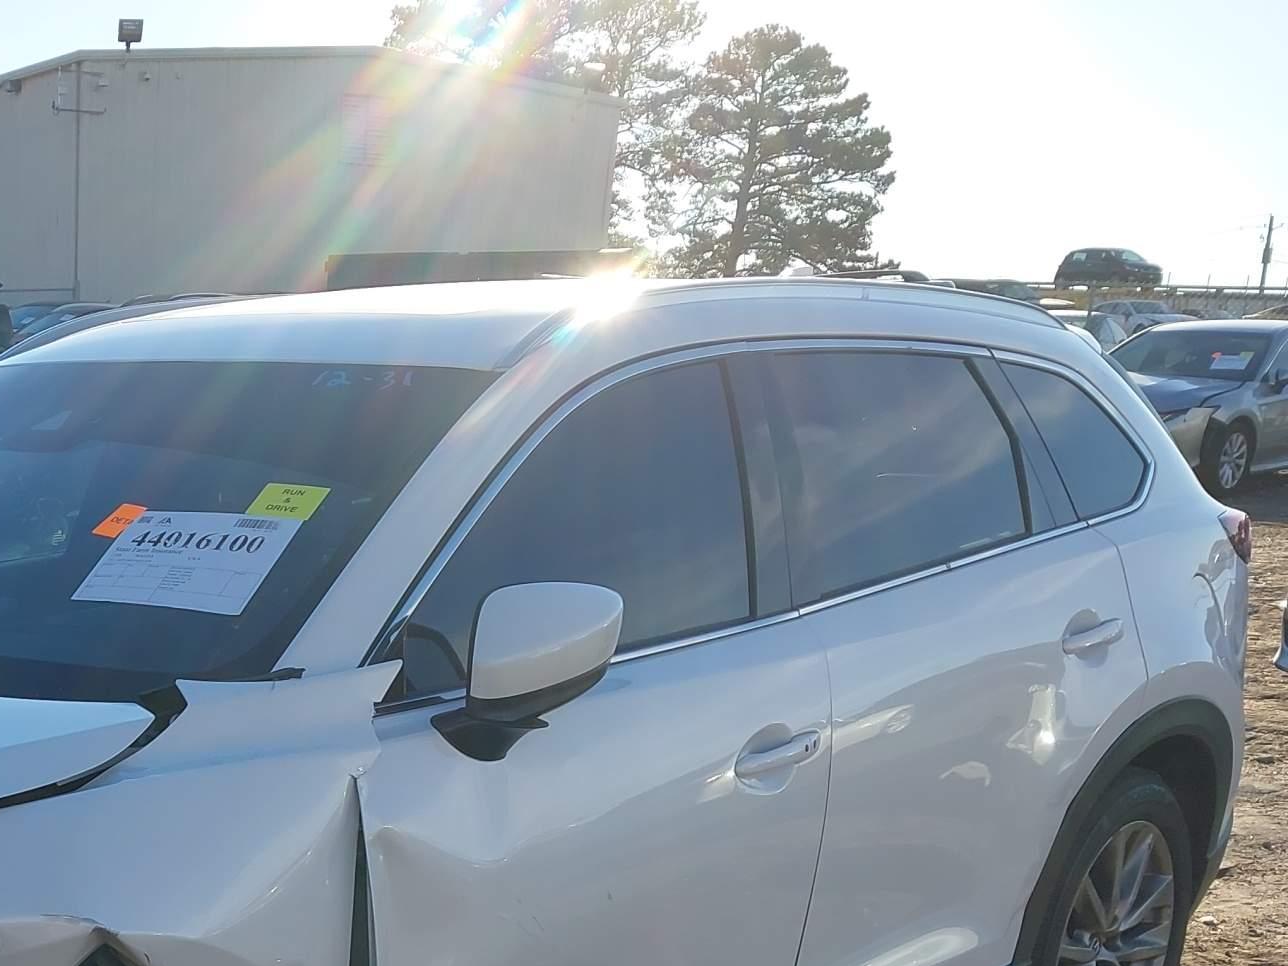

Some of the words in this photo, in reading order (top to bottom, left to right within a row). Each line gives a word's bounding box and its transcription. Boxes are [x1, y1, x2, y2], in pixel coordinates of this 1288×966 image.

[282, 488, 306, 496] RUN
[265, 504, 299, 513] DRIVE
[132, 530, 266, 554] 44016100
